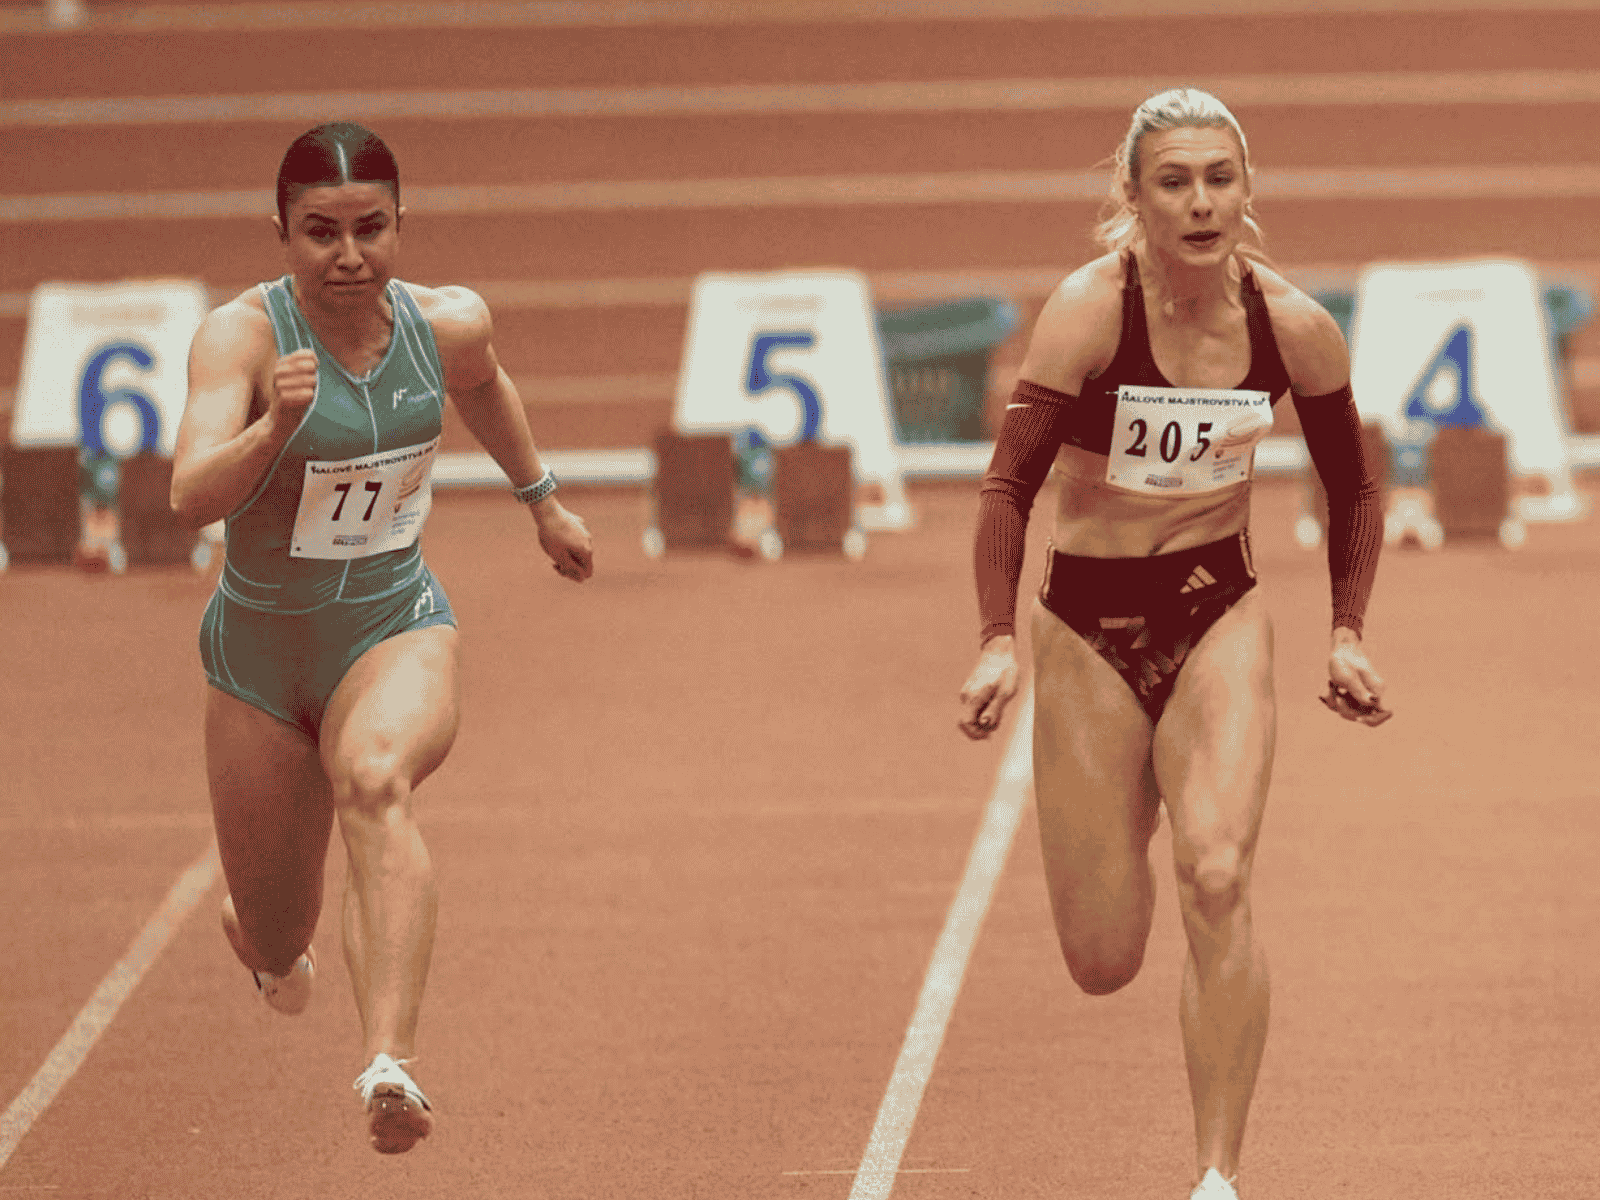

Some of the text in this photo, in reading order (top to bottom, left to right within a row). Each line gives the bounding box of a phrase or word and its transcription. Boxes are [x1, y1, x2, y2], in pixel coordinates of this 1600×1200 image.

[78, 339, 162, 458] 6
[745, 331, 823, 446] 5
[1404, 323, 1487, 431] 4
[1124, 418, 1213, 463] 205
[331, 480, 383, 522] 77
